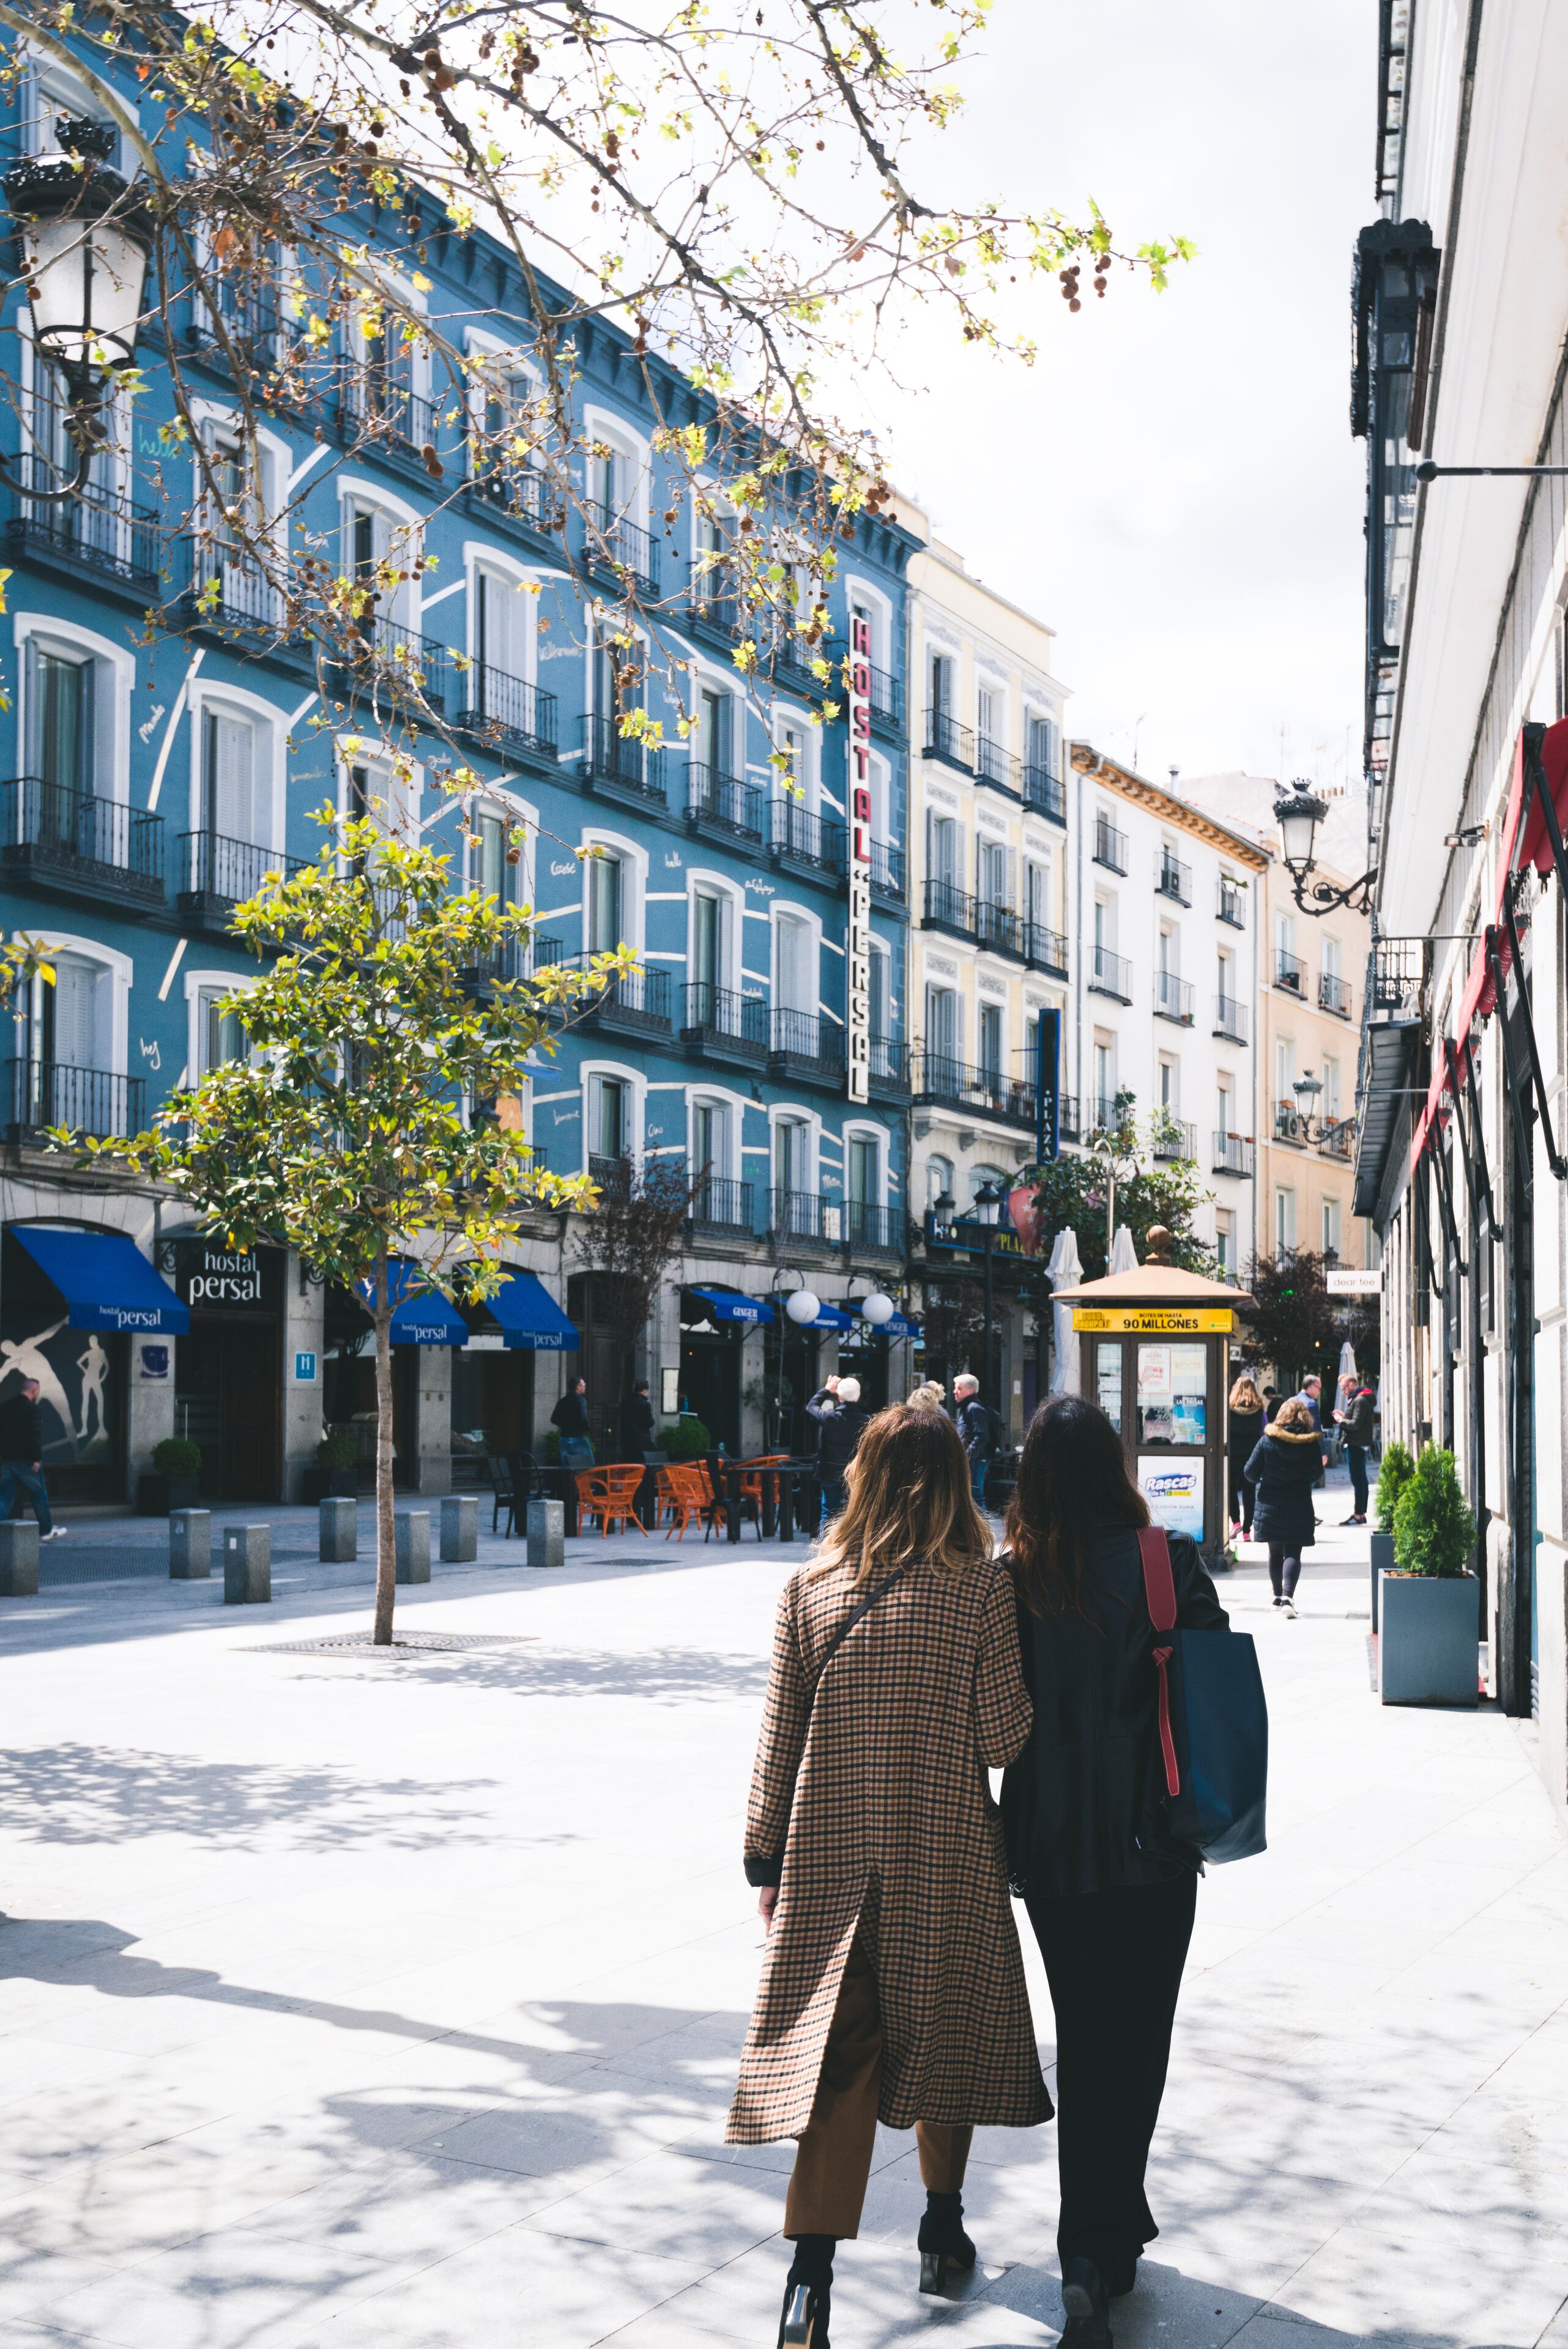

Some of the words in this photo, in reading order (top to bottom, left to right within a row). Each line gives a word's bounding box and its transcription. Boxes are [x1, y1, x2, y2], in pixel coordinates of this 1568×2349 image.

[854, 618, 871, 863] HOSTAL
[140, 1037, 161, 1070] hey
[1043, 1097, 1052, 1157] PLAZA
[205, 1250, 257, 1272] hostal
[189, 1271, 261, 1305] persal
[1334, 1278, 1356, 1286] dear
[118, 1308, 161, 1329] persal
[733, 1306, 758, 1317] GINGER
[415, 1324, 447, 1343] persal
[1123, 1319, 1139, 1329] 90
[1142, 1319, 1198, 1329] MILLONES
[534, 1332, 562, 1348] persal
[1146, 1476, 1196, 1491] Rascas
